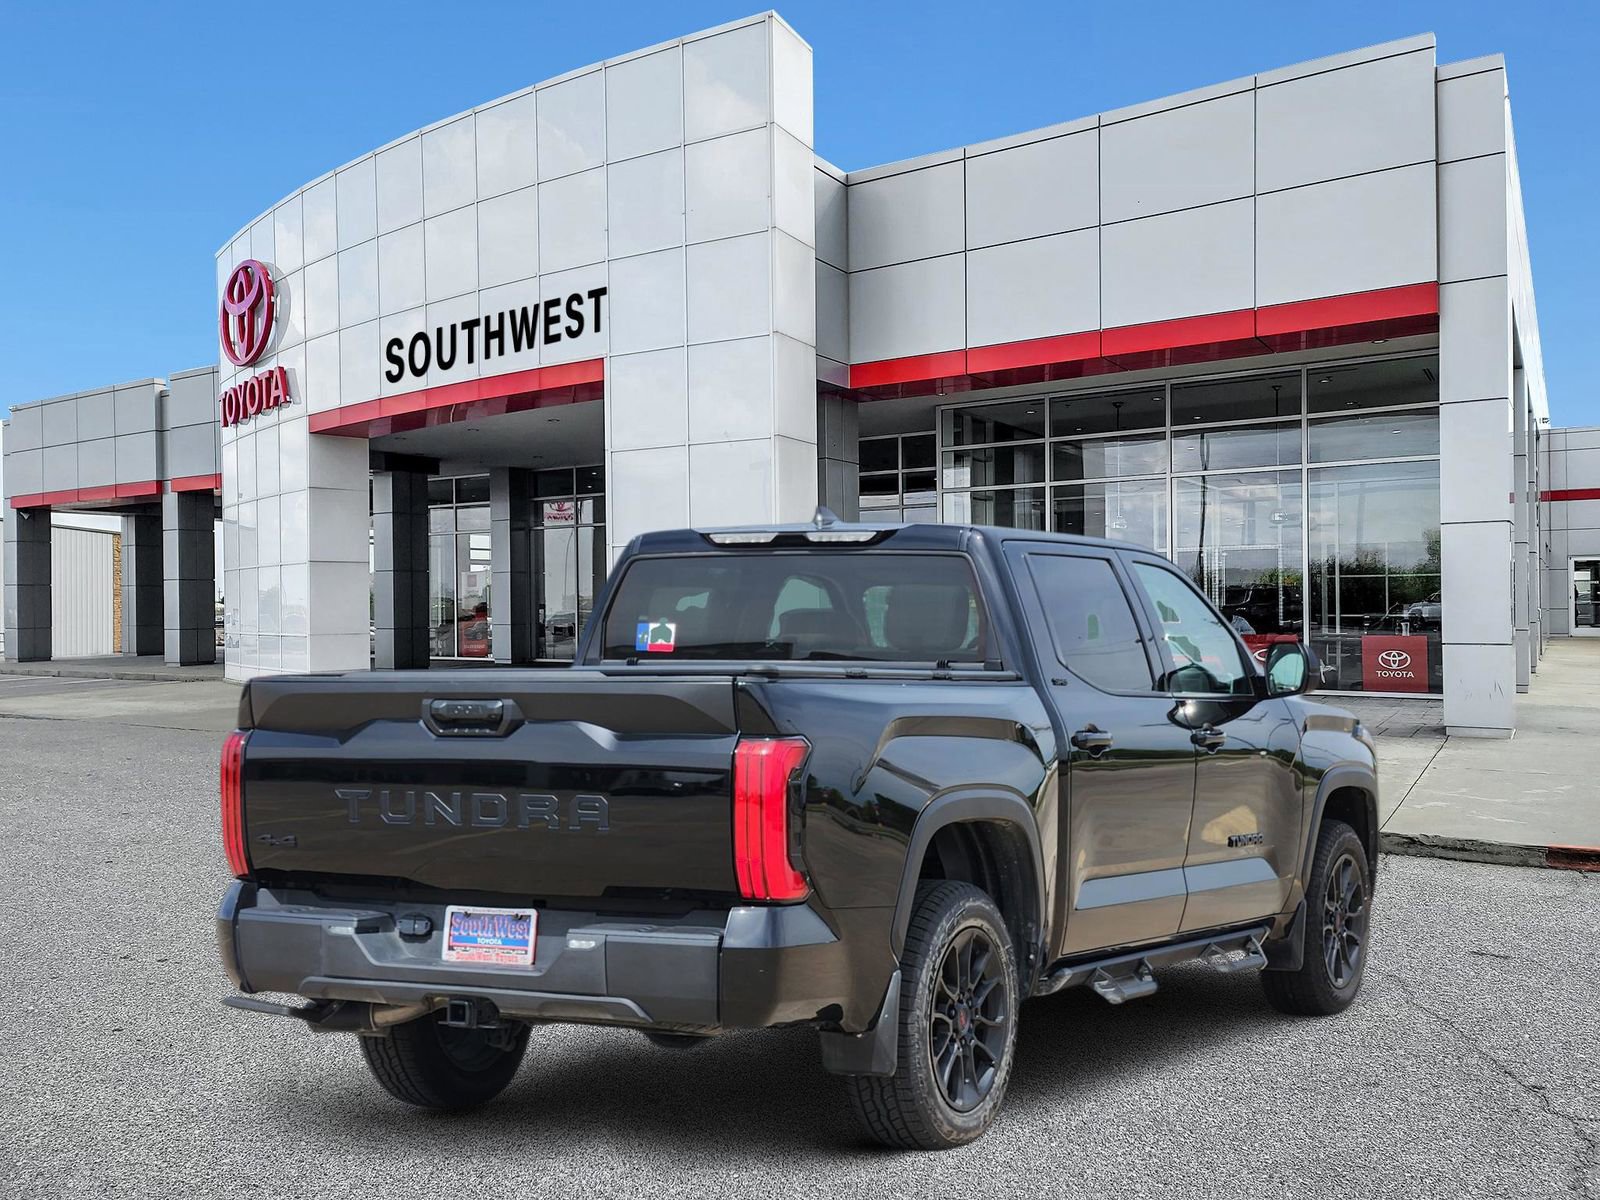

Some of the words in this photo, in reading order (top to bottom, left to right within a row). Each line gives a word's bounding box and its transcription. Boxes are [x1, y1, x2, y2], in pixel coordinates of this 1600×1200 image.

[385, 286, 608, 383] SOUTHWEST
[218, 366, 291, 428] TOYOTA
[1376, 670, 1415, 678] TOYOTA
[334, 788, 610, 831] TUNDRA
[477, 937, 502, 945] TOYOTA
